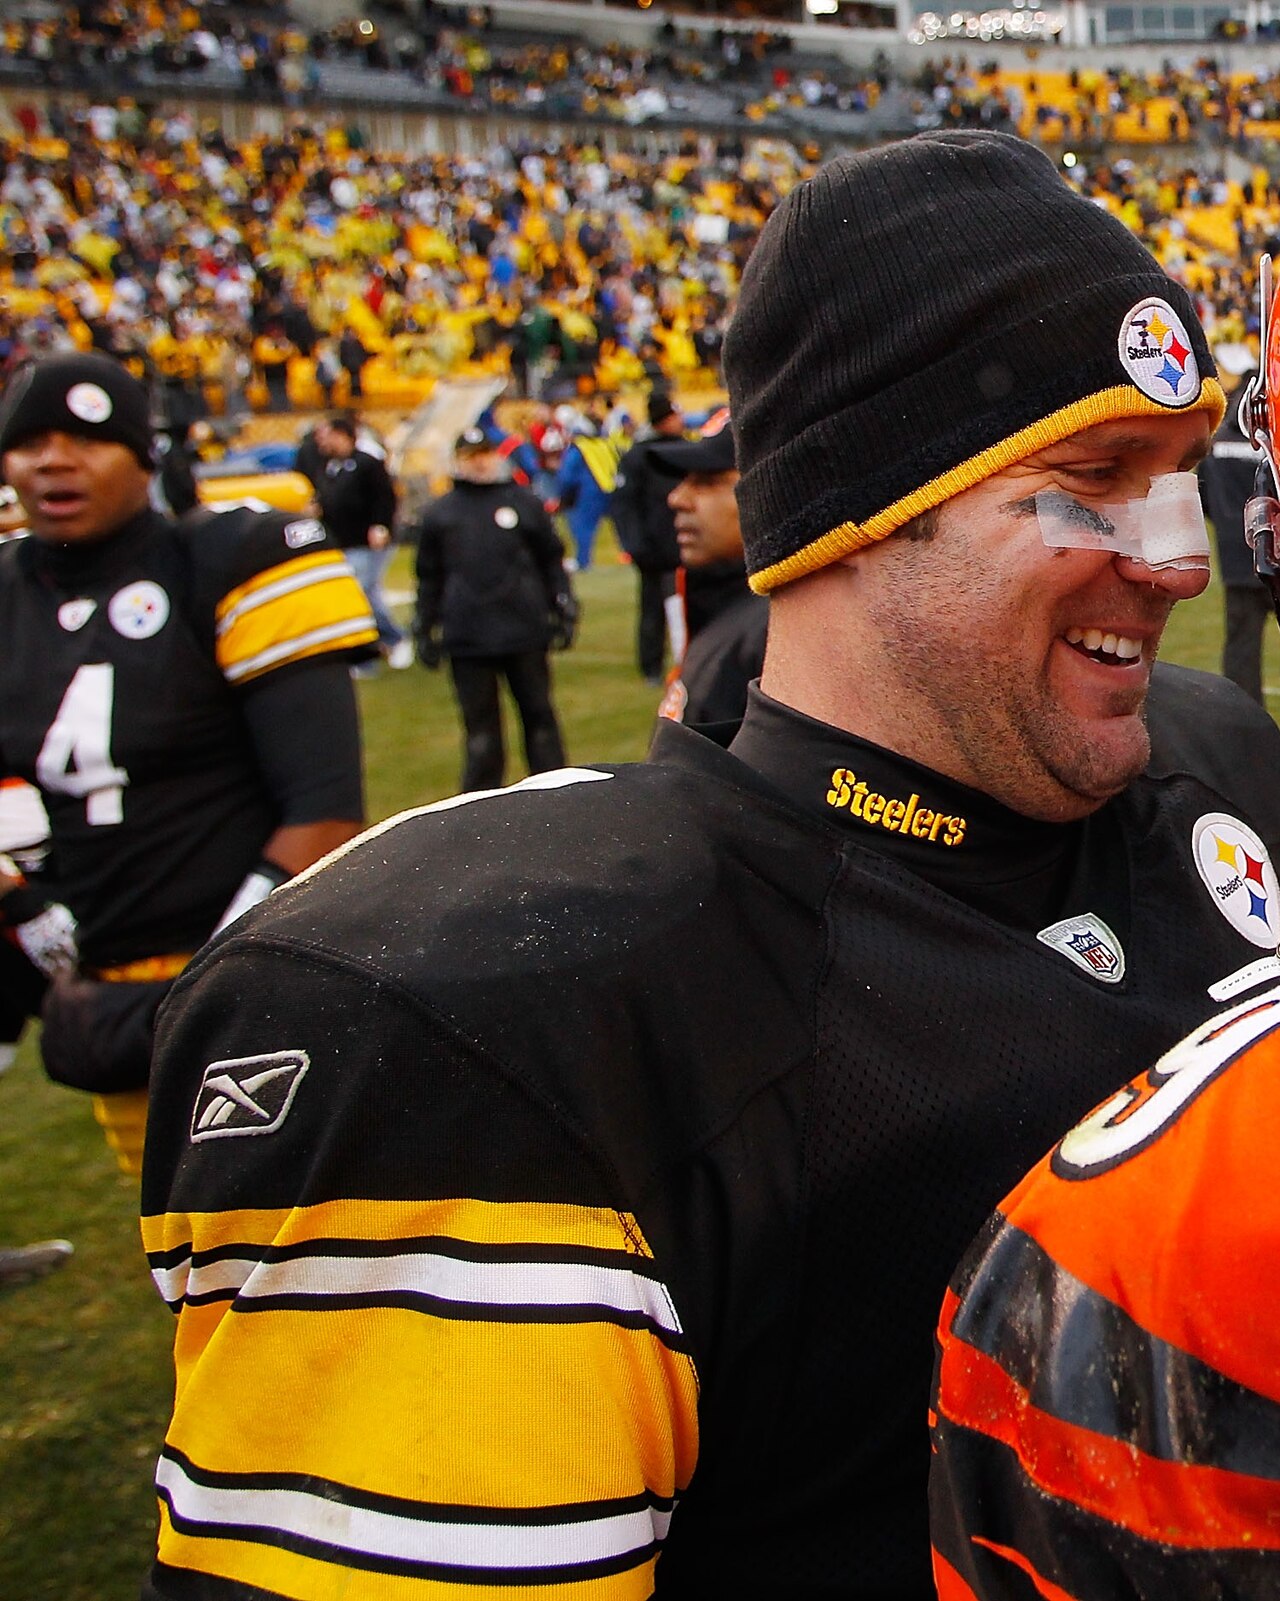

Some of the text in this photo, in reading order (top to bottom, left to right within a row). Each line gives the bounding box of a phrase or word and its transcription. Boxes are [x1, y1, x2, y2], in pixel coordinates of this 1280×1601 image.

[1127, 345, 1163, 360] Steelers
[36, 662, 130, 826] 4
[827, 768, 967, 846] Steelers
[1216, 875, 1244, 901] Steelers
[1083, 946, 1115, 969] NFL
